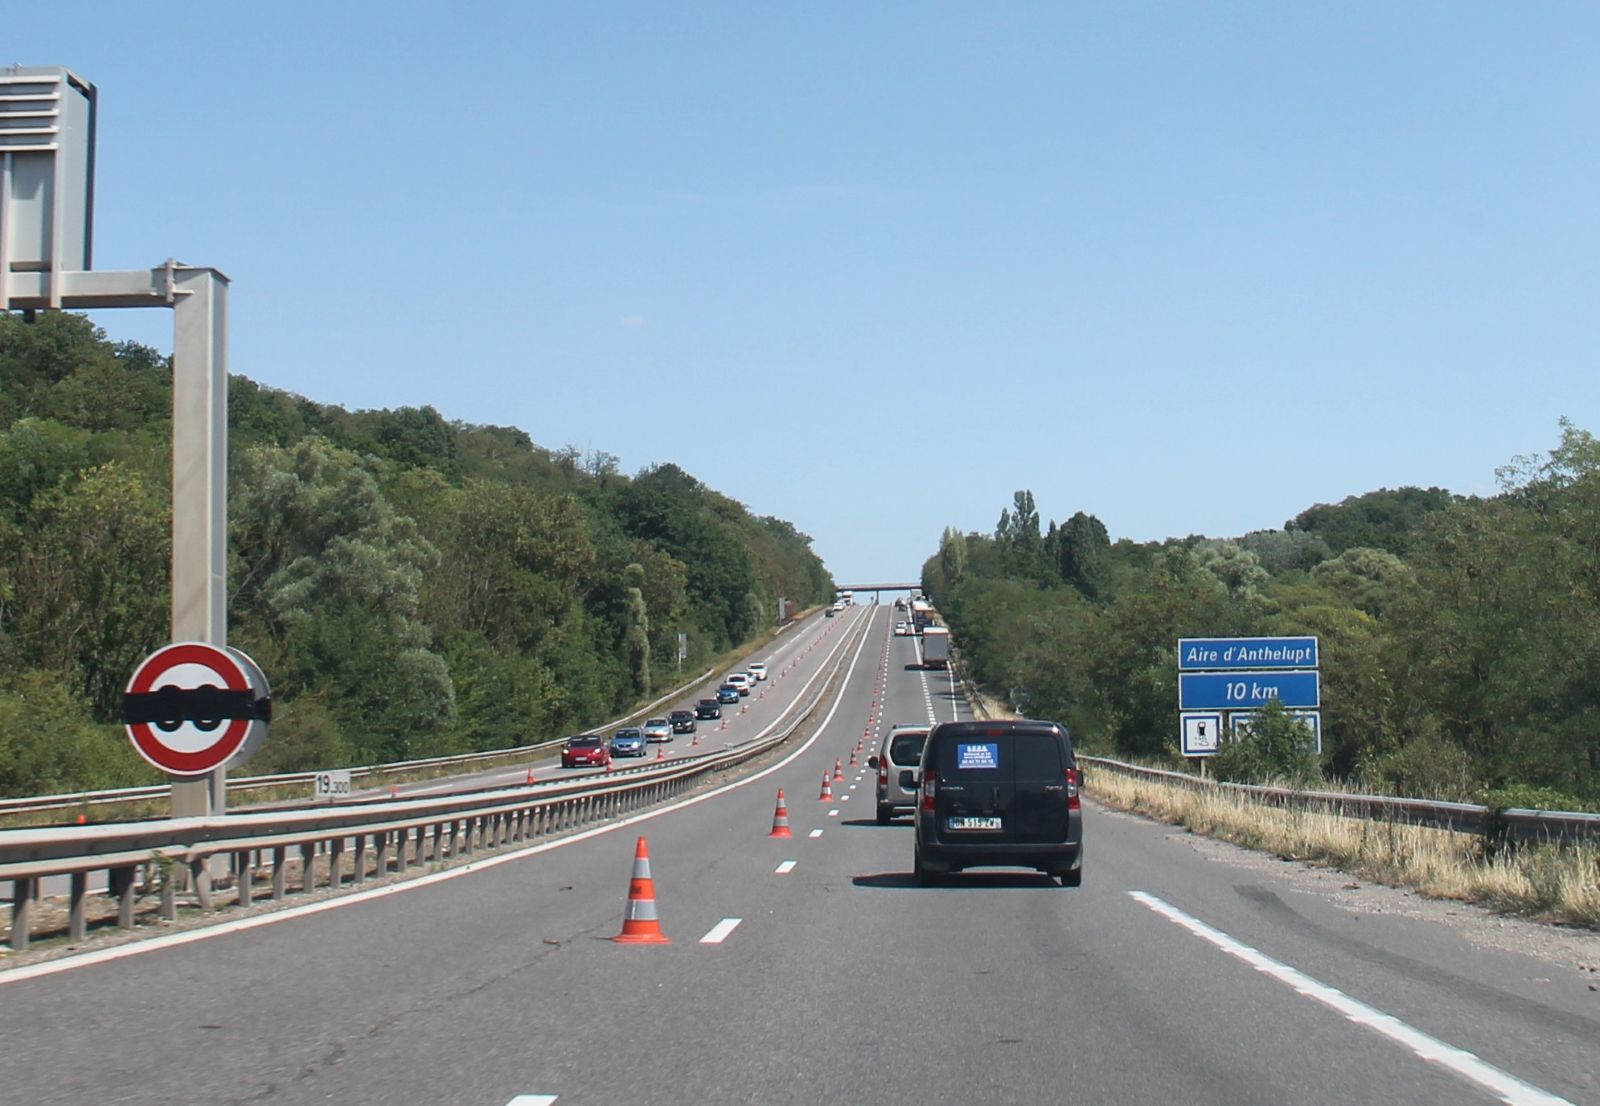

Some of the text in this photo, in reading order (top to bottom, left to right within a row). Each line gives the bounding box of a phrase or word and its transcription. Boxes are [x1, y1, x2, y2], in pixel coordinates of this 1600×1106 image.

[1186, 645, 1312, 664] Aire d'Anthelupt
[1225, 682, 1279, 700] 10 km
